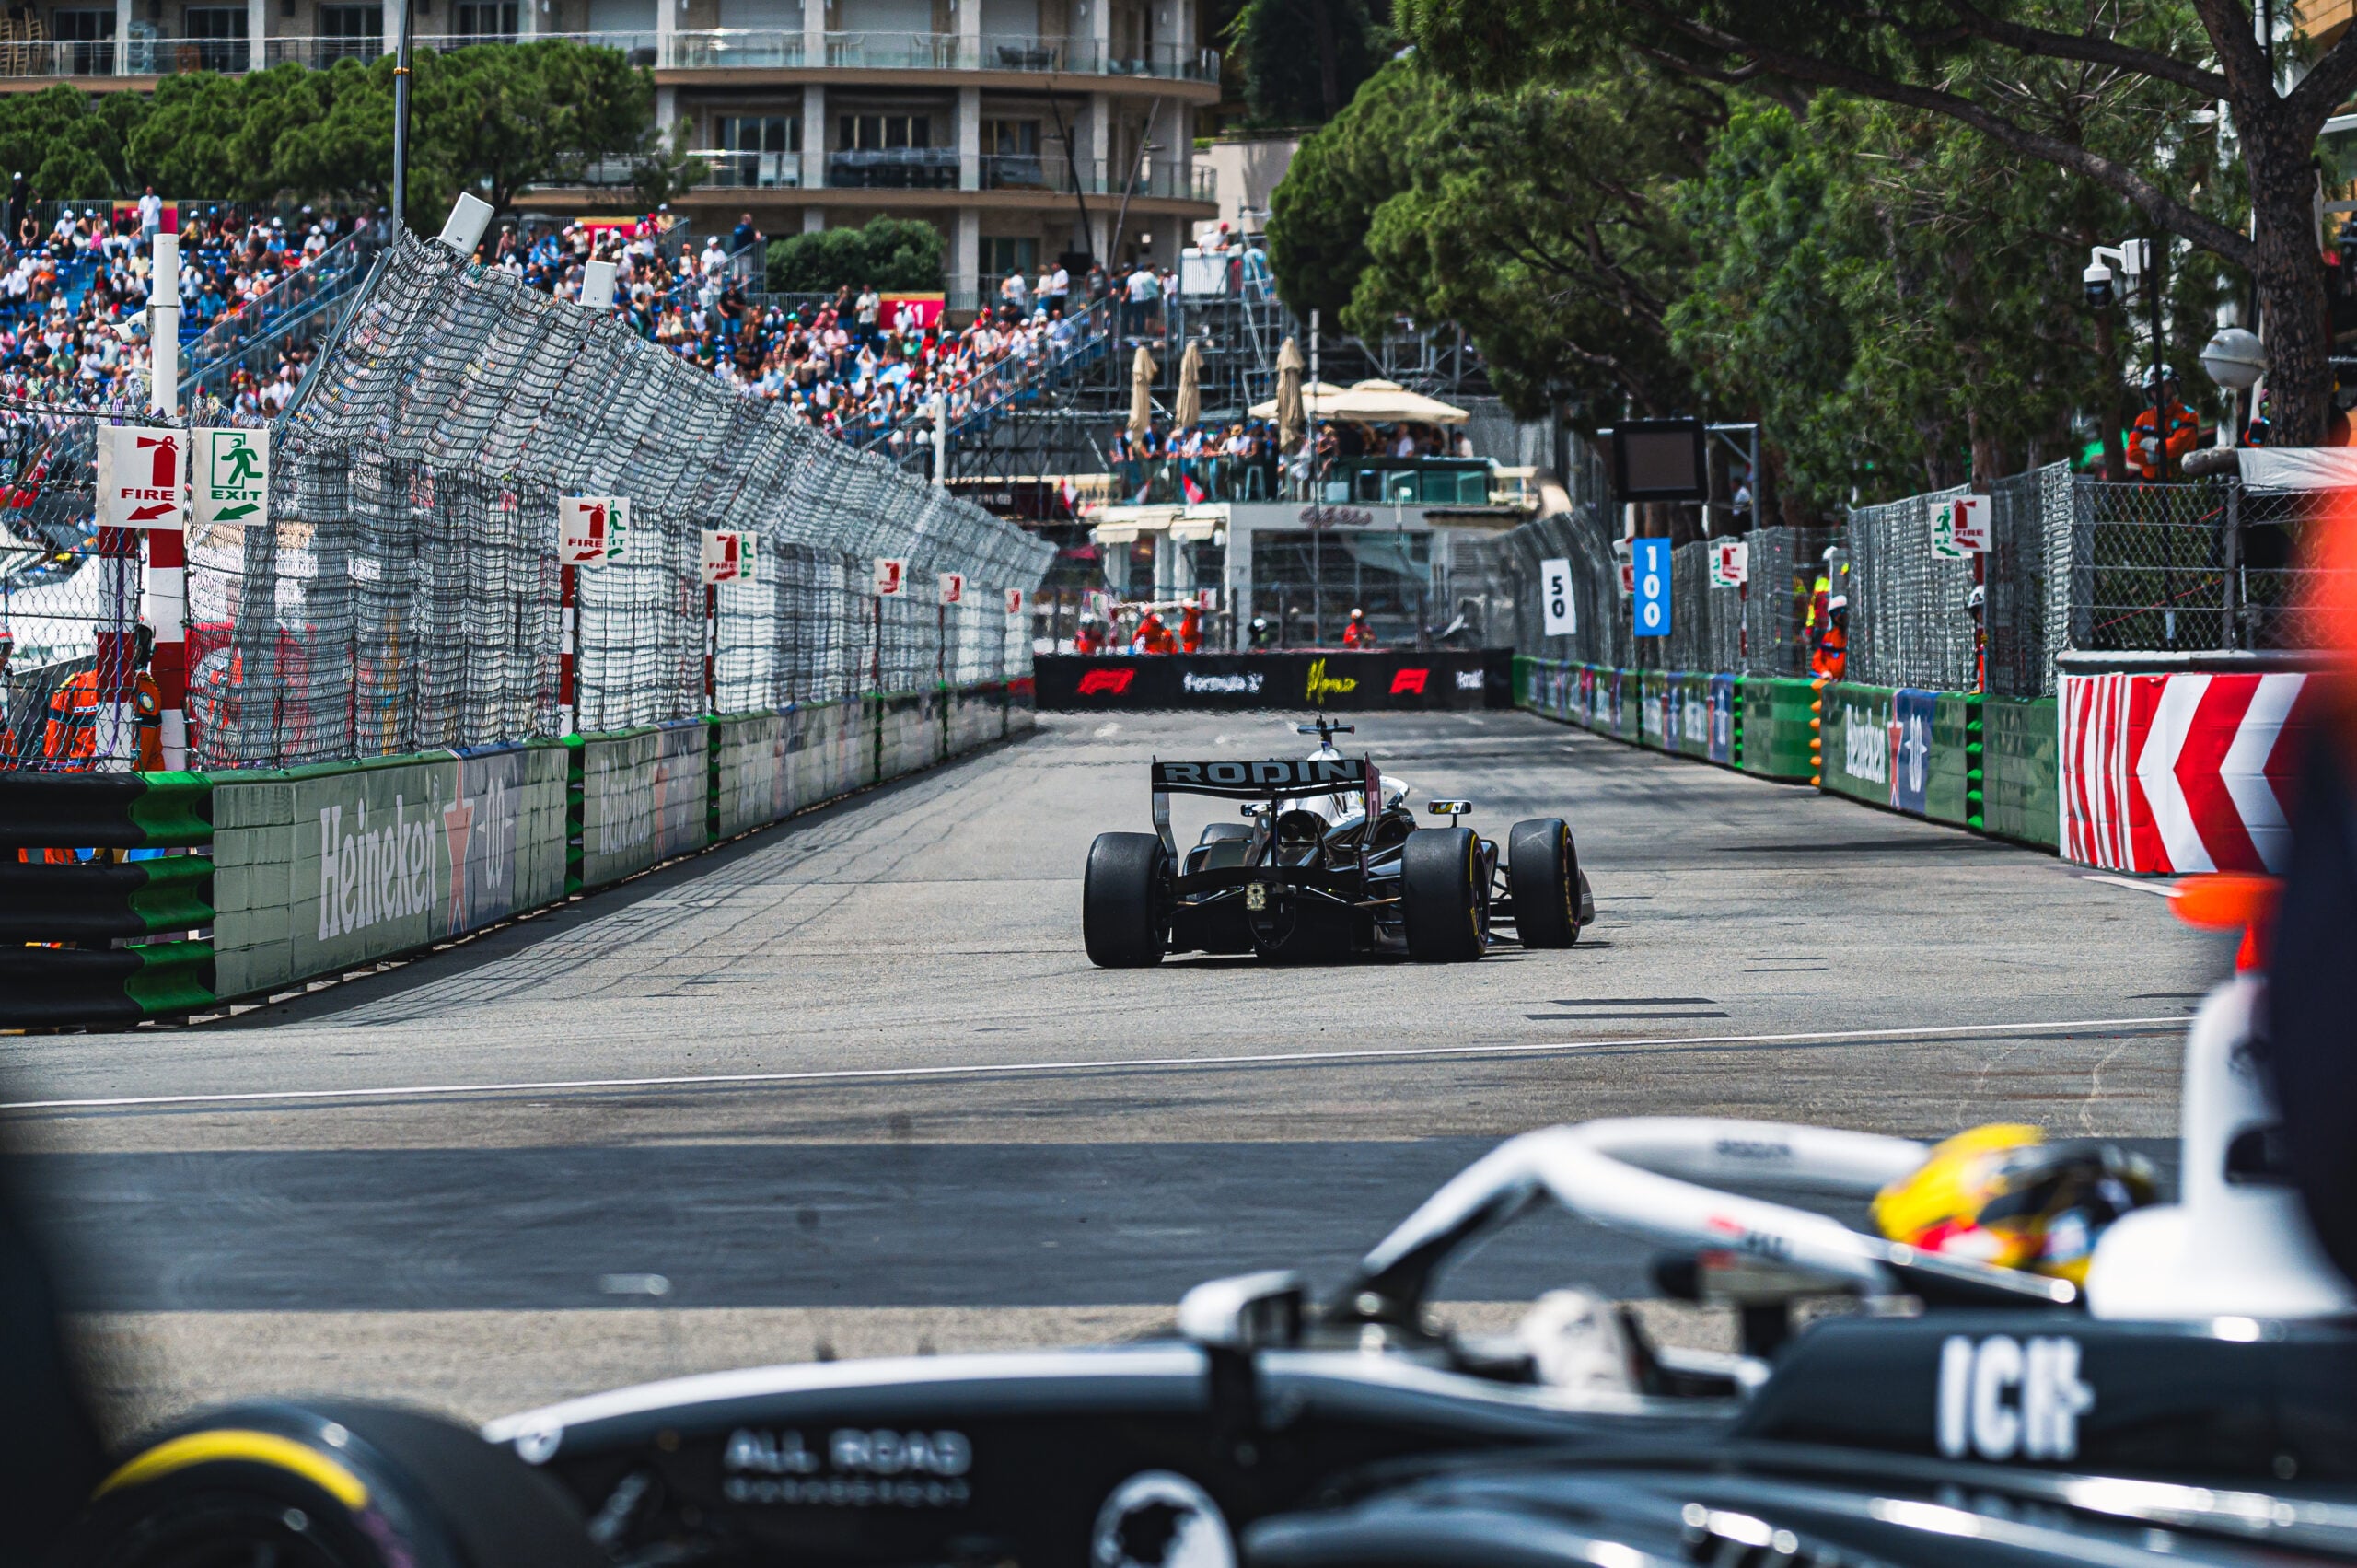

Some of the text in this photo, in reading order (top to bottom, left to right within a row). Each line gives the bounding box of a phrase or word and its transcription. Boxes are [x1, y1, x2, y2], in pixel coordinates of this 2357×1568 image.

[121, 488, 175, 501] FIRE
[211, 489, 262, 501] EXIT
[568, 538, 603, 548] FIRE
[1551, 575, 1565, 618] 50
[1643, 545, 1661, 628] 100
[1163, 761, 1358, 783] RODIN
[318, 794, 437, 941] Heineken
